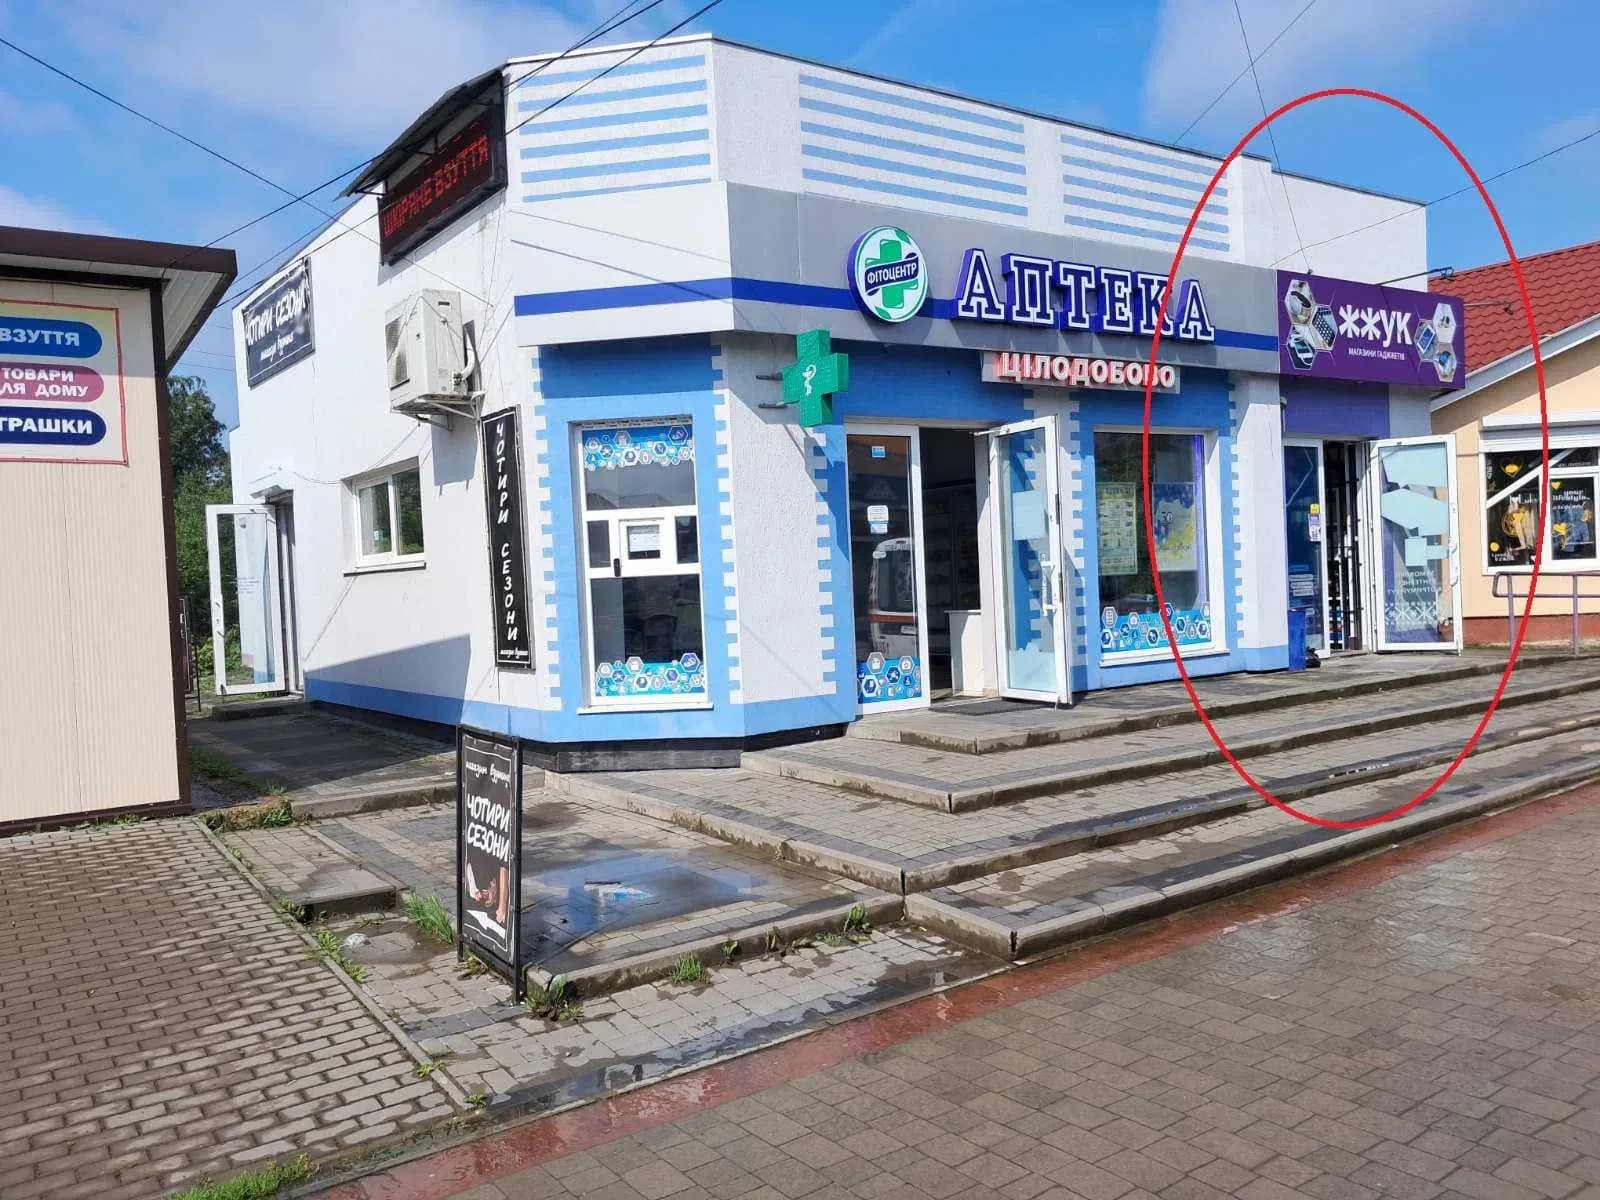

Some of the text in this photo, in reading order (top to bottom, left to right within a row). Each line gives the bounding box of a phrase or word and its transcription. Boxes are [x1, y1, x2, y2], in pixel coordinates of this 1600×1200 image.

[867, 263, 917, 285] ФІТОЦЕНТР
[952, 248, 1215, 342] АПТЕКА
[0, 328, 80, 346] ВЗУТТЯ
[1339, 304, 1413, 348] ЖЖУК
[2, 367, 74, 382] ТОВАРИ
[1000, 352, 1176, 388] ЦІЛОДОБОВО
[35, 384, 89, 397] ДОМУ
[496, 422, 518, 640] ЧОТИРИ СЕЗОНИ
[467, 793, 510, 832] ЧОТИРИ
[467, 822, 510, 862] СЕЗОНИ
